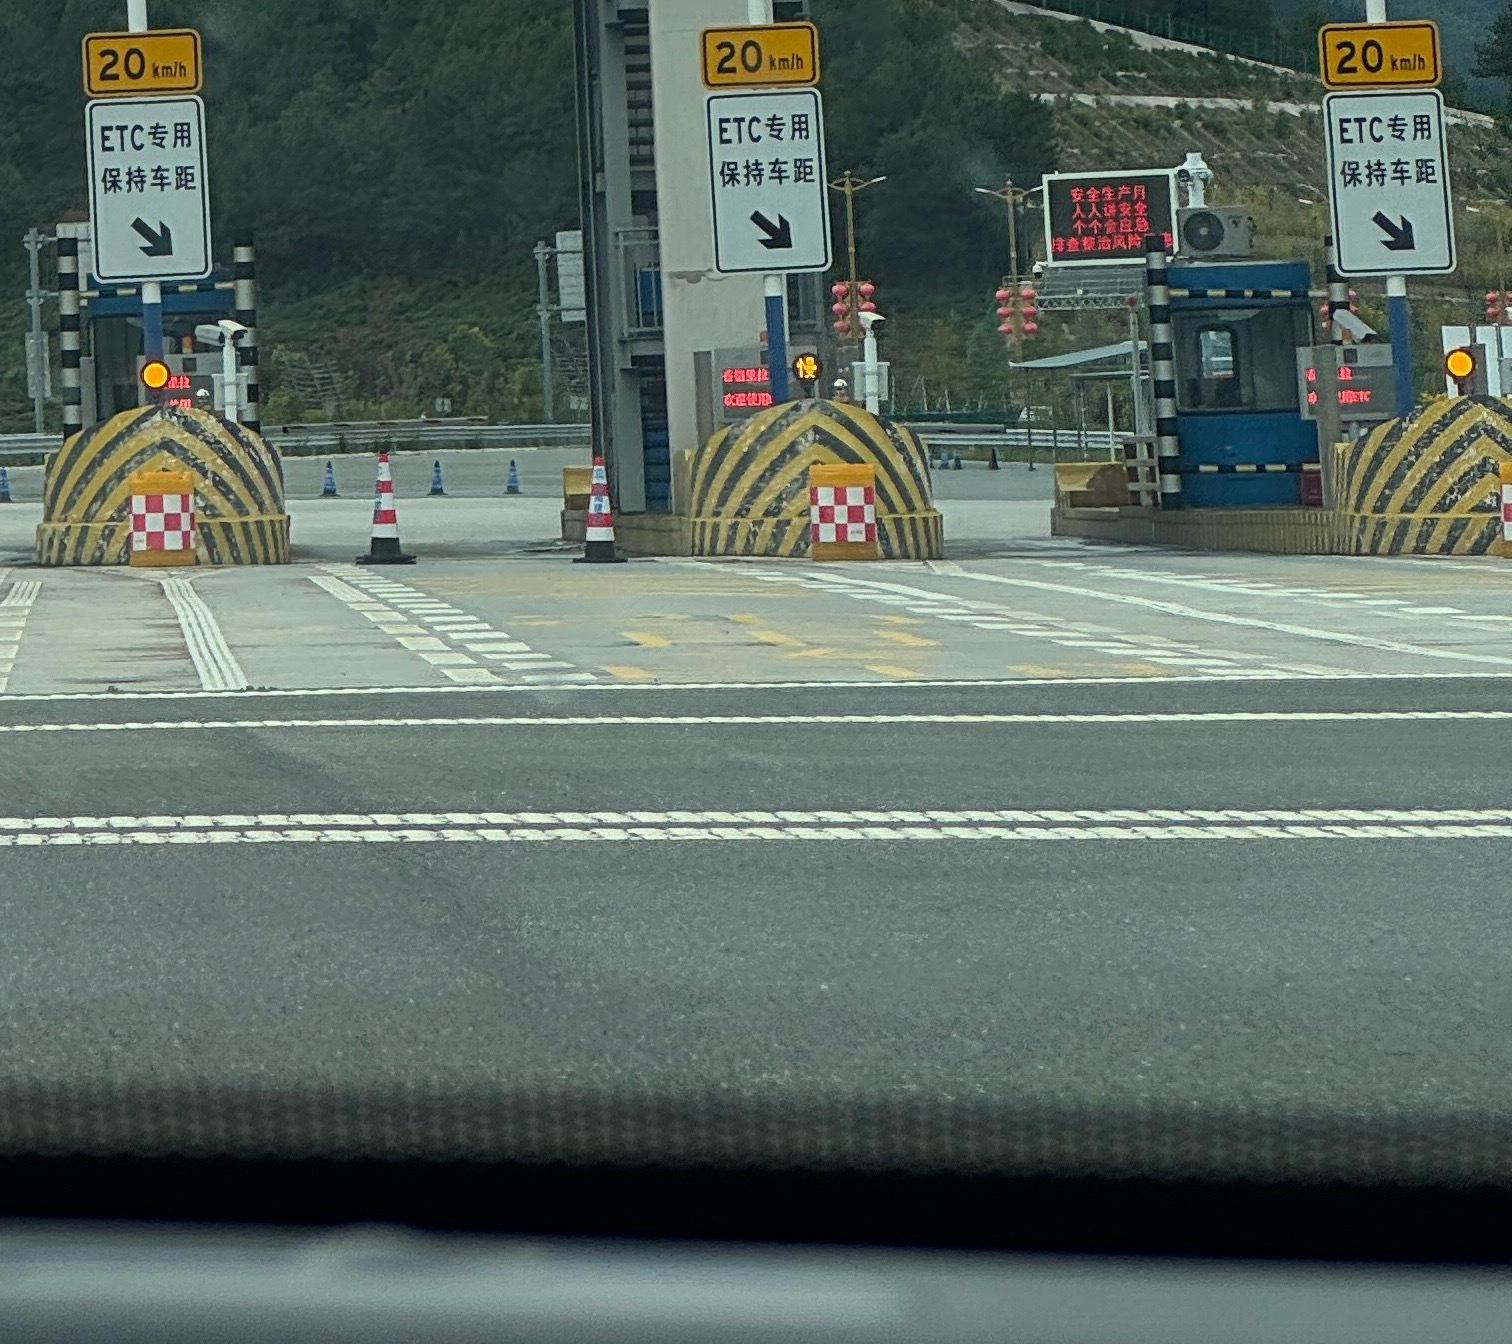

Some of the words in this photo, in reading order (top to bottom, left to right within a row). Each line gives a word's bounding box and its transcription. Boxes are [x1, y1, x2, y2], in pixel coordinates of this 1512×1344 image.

[98, 47, 146, 82] 20
[151, 61, 188, 80] km/h
[715, 39, 763, 75] 20
[768, 52, 805, 72] km/h
[1335, 39, 1384, 75] 20
[1389, 53, 1426, 72] km/h
[100, 121, 192, 153] ETC专用
[718, 113, 810, 145] ETC专用
[1338, 114, 1432, 145] ETC专用
[100, 164, 197, 195] 保持车距
[718, 157, 816, 188] 保持车距
[1339, 157, 1438, 188] 保持车距
[796, 356, 818, 379] 慢
